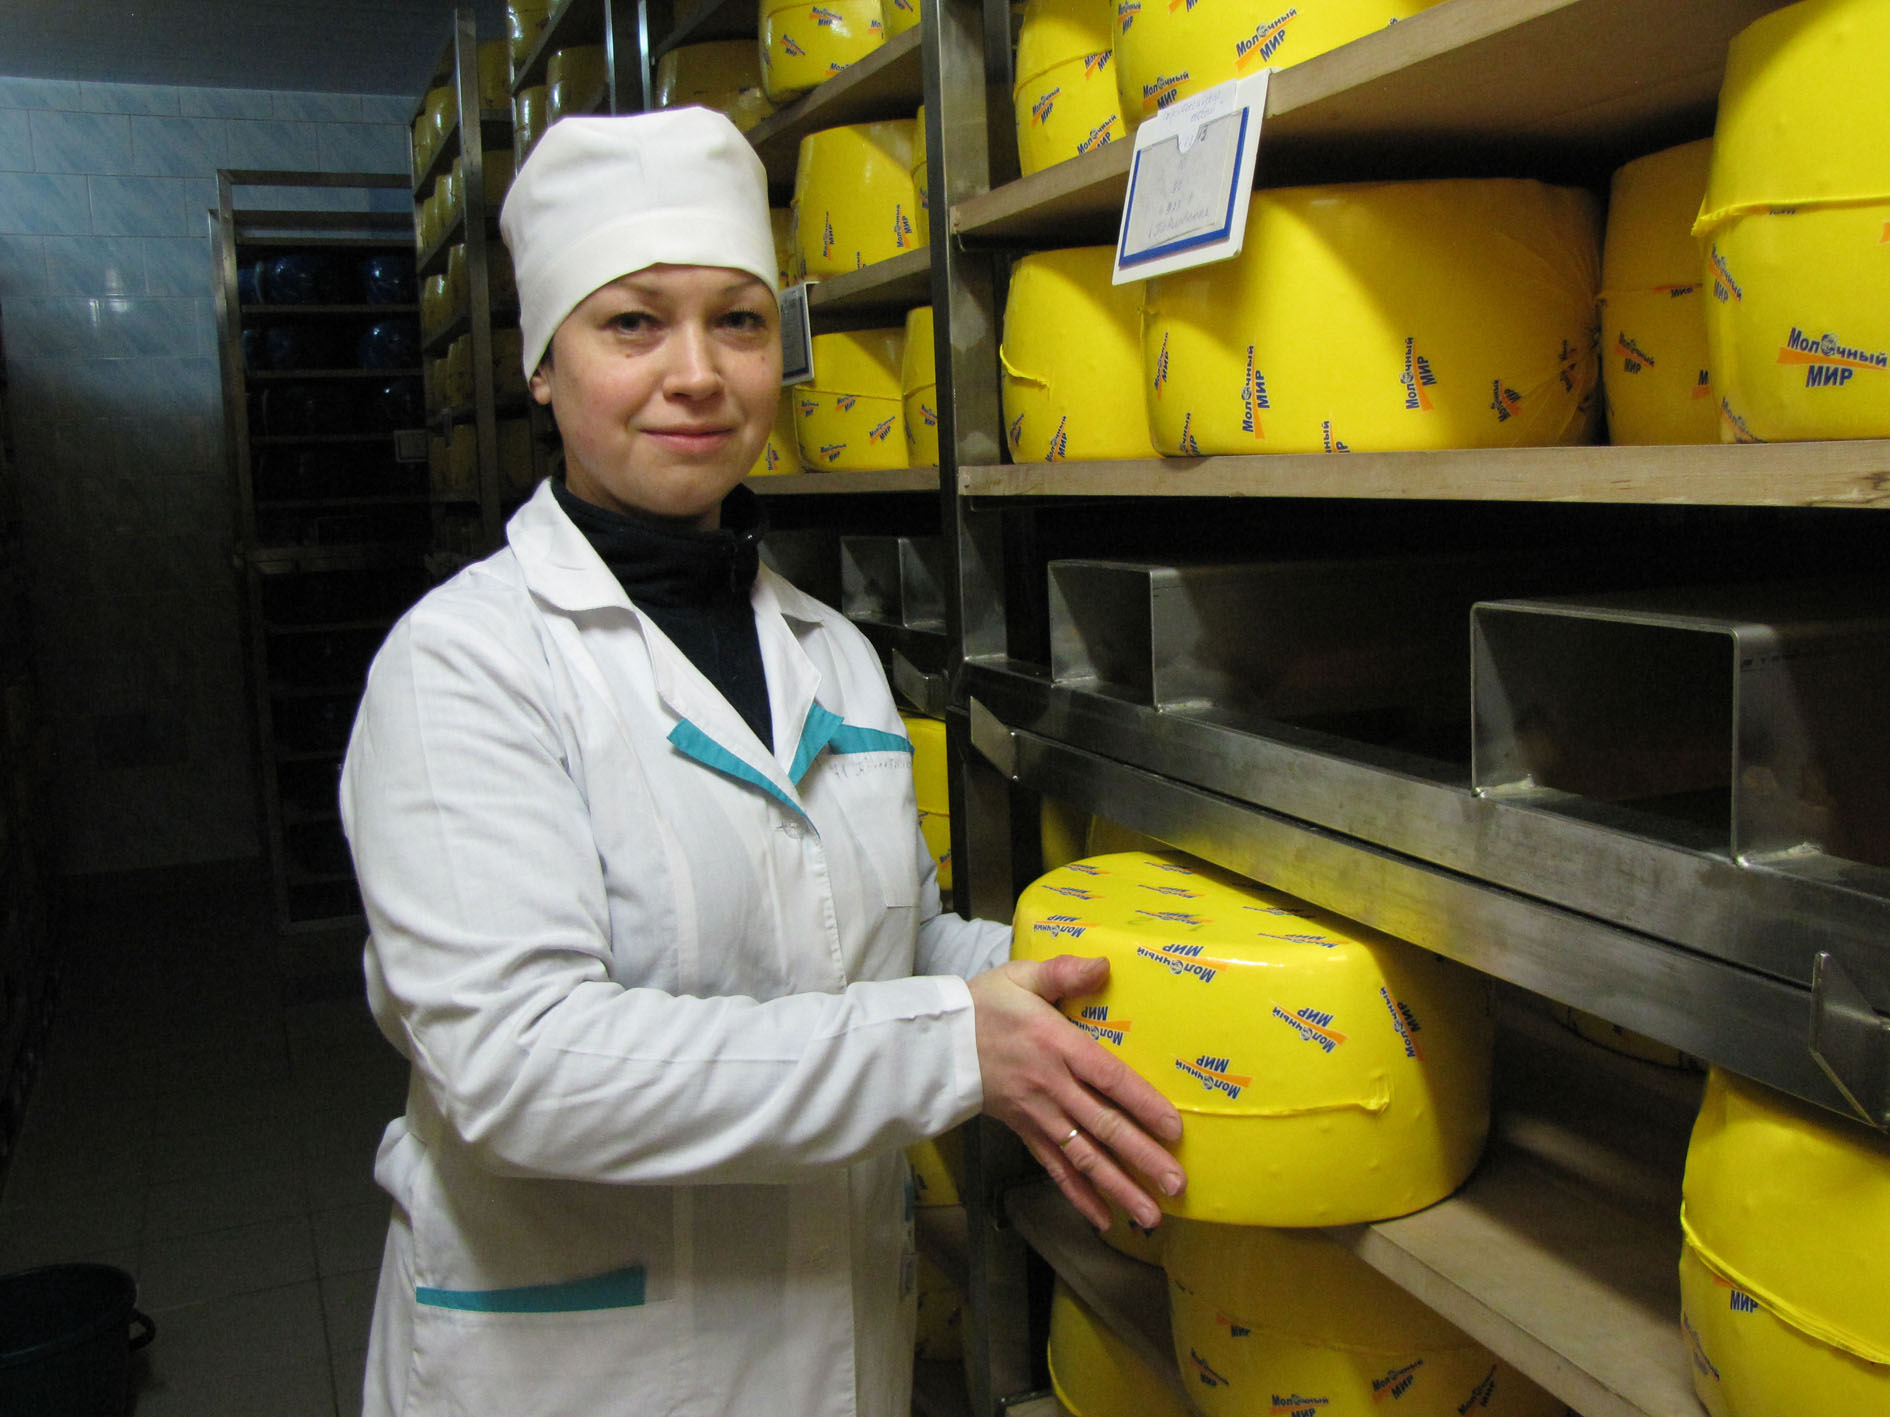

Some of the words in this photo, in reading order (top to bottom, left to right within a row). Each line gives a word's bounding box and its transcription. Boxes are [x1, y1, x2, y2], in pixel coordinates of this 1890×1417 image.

[1236, 8, 1297, 58] Молочный
[1260, 29, 1286, 61] МИР
[1143, 71, 1190, 98] Молочный
[1157, 89, 1178, 110] МИР
[1041, 102, 1054, 126] МИР
[1077, 115, 1117, 154] Молочный
[1788, 326, 1888, 369] Молочный
[1400, 337, 1420, 409] Молочный
[1417, 356, 1437, 387] МИР
[1806, 364, 1853, 388] МИР
[1242, 345, 1254, 432] Молочный
[1256, 370, 1270, 409] МИР
[1137, 946, 1216, 983] Молочный
[1162, 944, 1204, 958] МИР
[1081, 1006, 1108, 1021] МИР
[1297, 1008, 1333, 1028] МИР
[1380, 987, 1416, 1058] Молочный
[1397, 1002, 1421, 1032] МИР
[1272, 1006, 1336, 1053] Молочный
[1176, 1058, 1240, 1100] Молочный
[1196, 1055, 1229, 1073] МИР
[1730, 1289, 1759, 1313] МИР
[1272, 1394, 1329, 1406] Молочный
[1391, 1373, 1414, 1399] МИР
